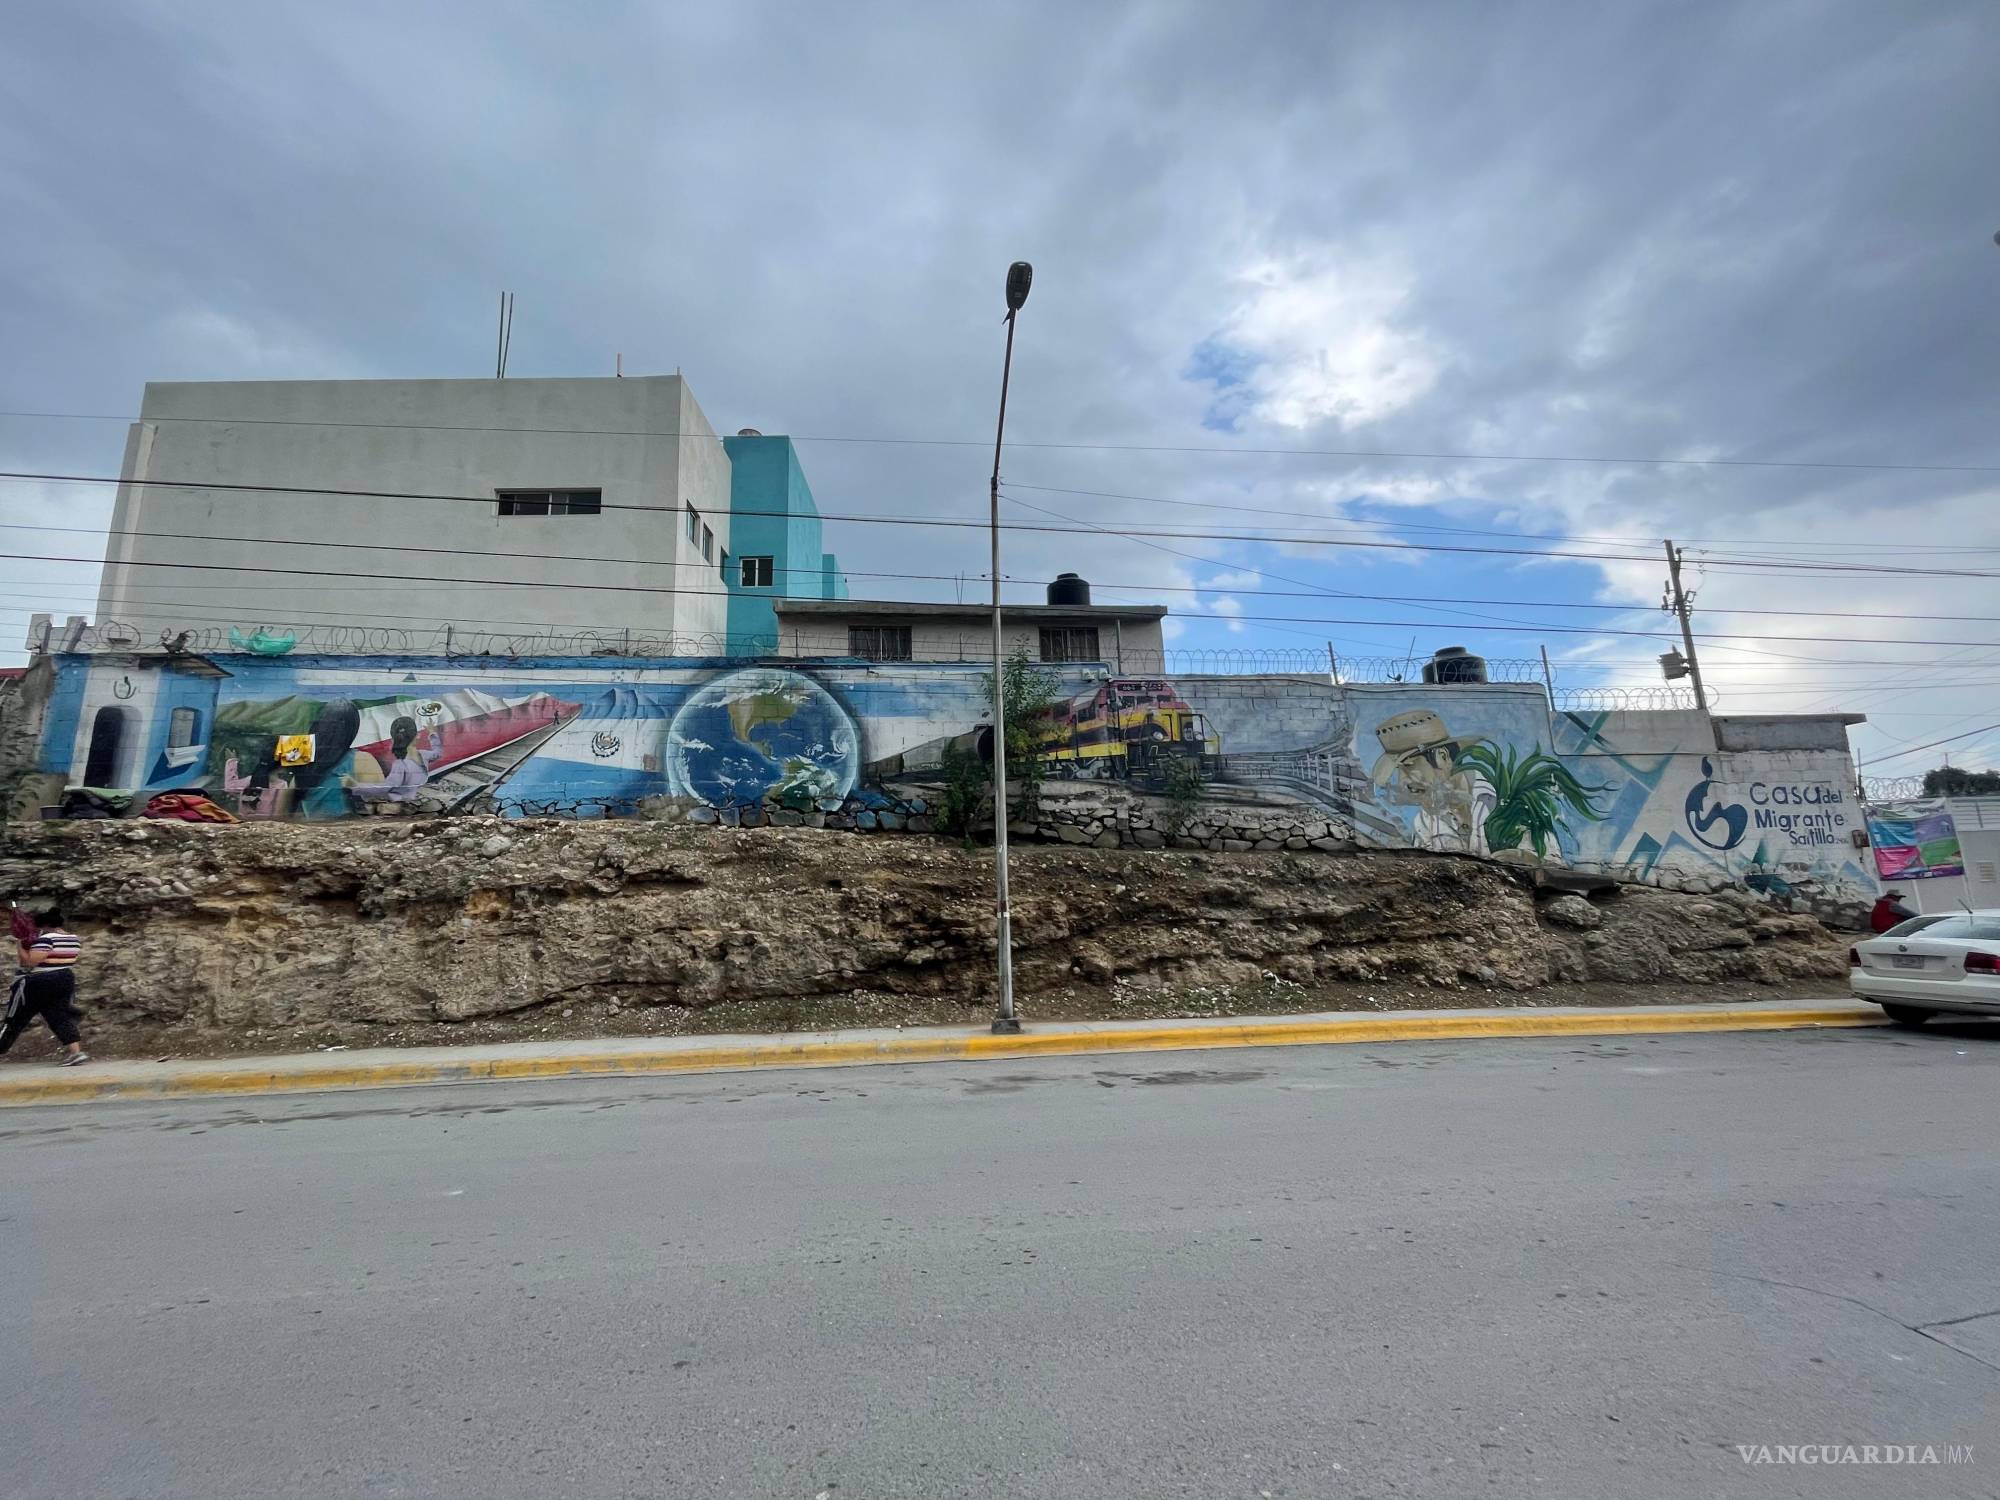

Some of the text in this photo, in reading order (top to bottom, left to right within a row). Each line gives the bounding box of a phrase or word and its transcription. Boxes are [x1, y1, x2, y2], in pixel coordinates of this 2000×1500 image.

[1750, 782, 1843, 805] Casa del
[1755, 809, 1845, 832] Migrante
